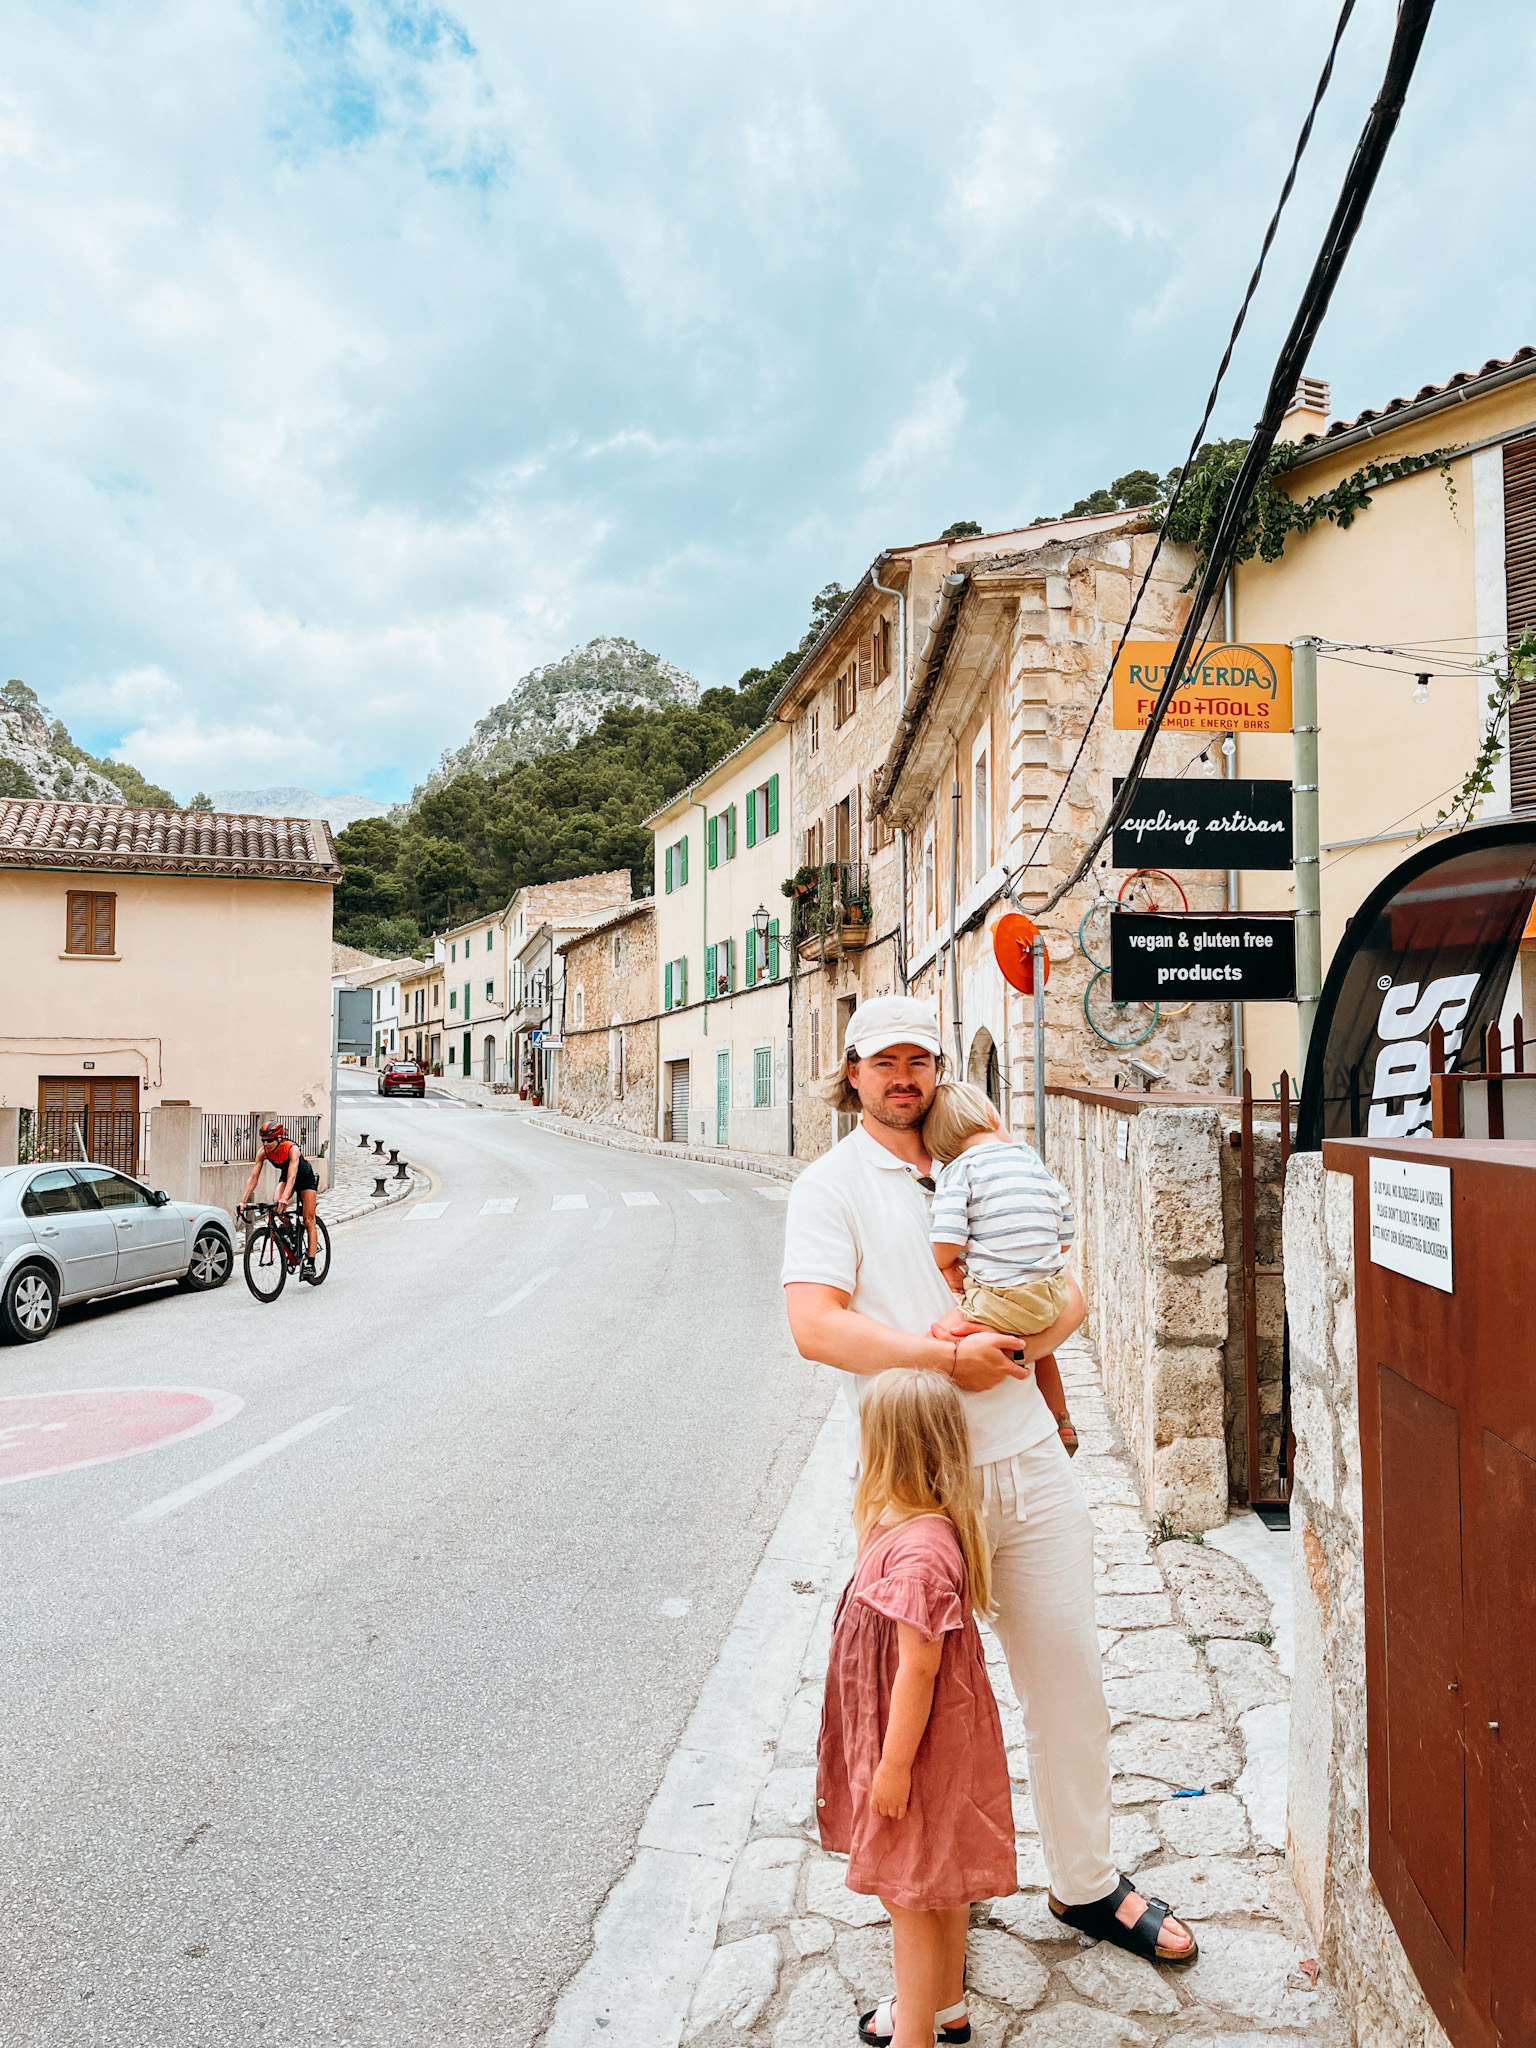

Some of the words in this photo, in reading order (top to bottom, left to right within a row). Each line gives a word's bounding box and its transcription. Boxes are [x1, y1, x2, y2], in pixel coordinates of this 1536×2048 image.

[1201, 718, 1239, 730] ENERGY
[1243, 720, 1270, 729] BARS
[1120, 809, 1200, 845] cycling
[1205, 810, 1285, 832] artisan
[1129, 935, 1173, 951] vegan
[1178, 932, 1189, 947] &
[1193, 932, 1240, 951] gluten
[1244, 932, 1273, 948] free
[1157, 964, 1242, 984] products
[1377, 1204, 1388, 1219] PLEASE
[1399, 1209, 1410, 1224] BLOCK
[1410, 1212, 1418, 1227] THE
[1418, 1214, 1440, 1232] PAVEMENT
